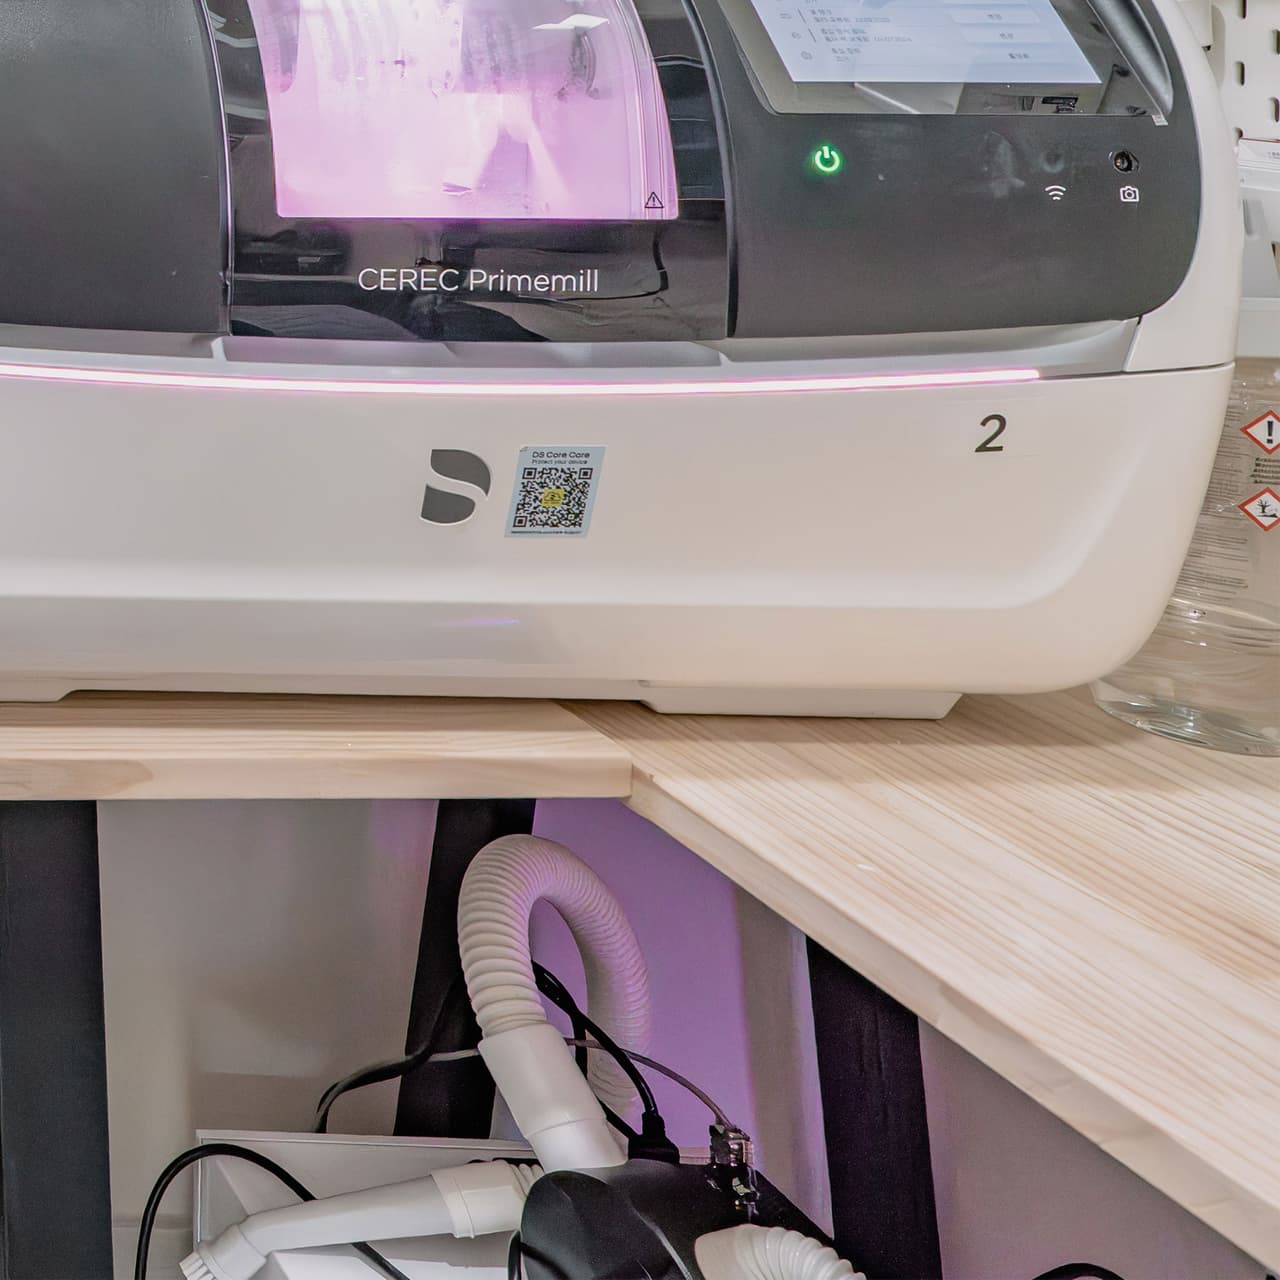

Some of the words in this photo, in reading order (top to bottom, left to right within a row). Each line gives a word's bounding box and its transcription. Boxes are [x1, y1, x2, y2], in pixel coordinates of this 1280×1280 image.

[358, 268, 460, 292] CEREC
[469, 268, 599, 292] Primemill
[974, 414, 1007, 452] 2
